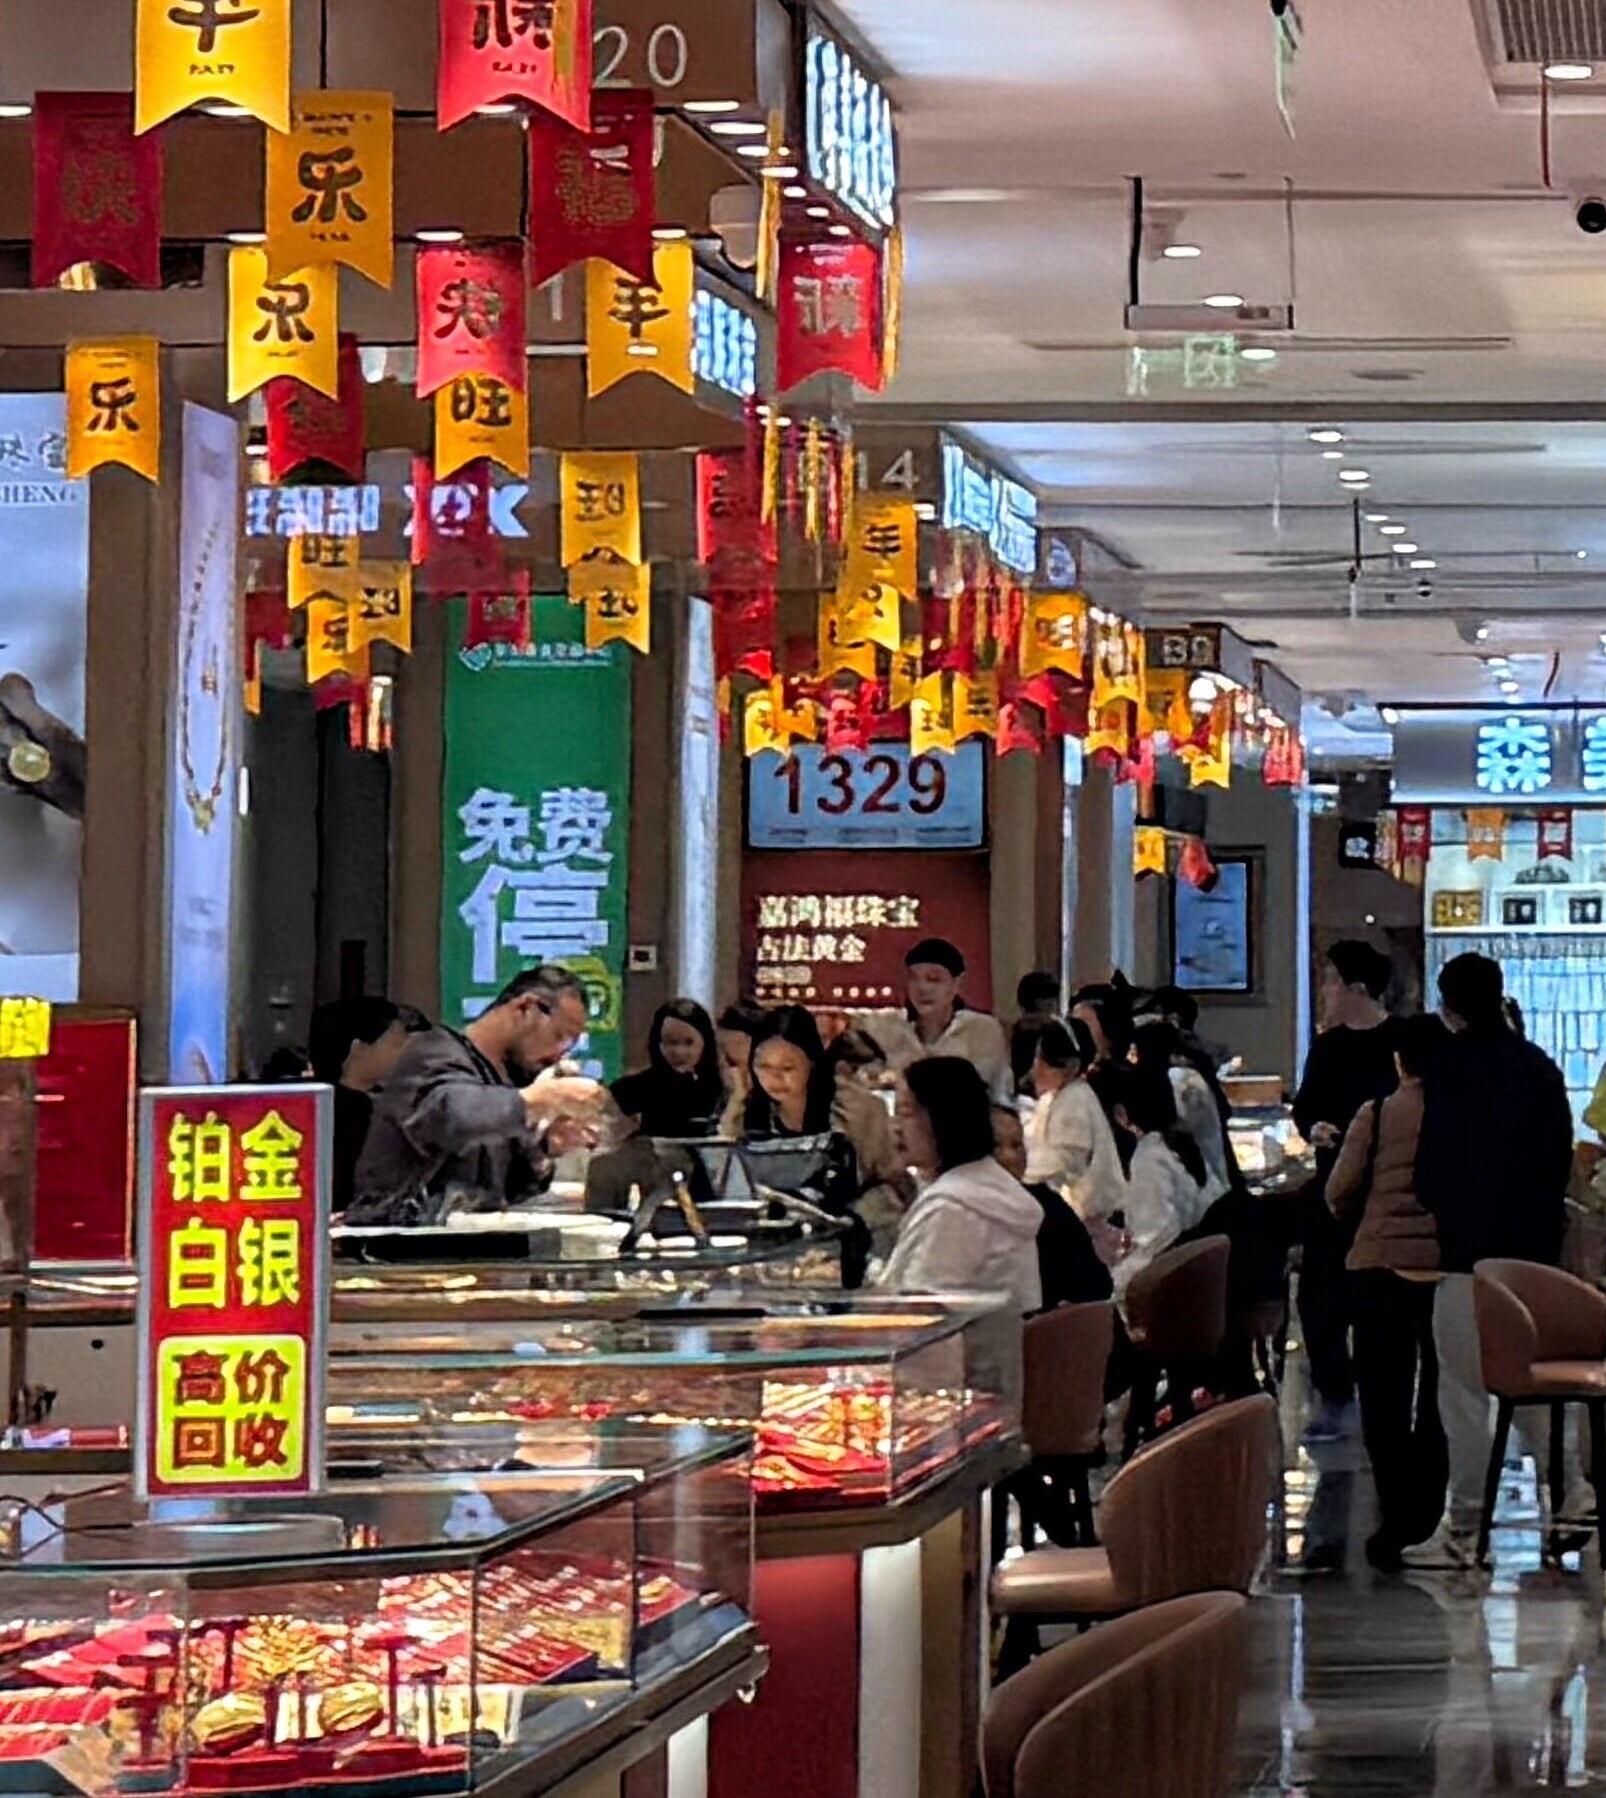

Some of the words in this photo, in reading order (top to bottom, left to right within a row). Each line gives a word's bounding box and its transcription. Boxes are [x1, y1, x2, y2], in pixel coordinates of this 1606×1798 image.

[592, 23, 687, 88] 20
[291, 146, 367, 223] 乐
[86, 376, 140, 433] 乐
[857, 449, 921, 490] 14
[774, 754, 947, 815] 1329
[459, 787, 613, 863] 免费
[459, 862, 608, 984] 停
[168, 1110, 303, 1203] 铂金
[168, 1217, 301, 1310] 白银
[173, 1349, 291, 1406] 高价
[173, 1413, 289, 1469] 回收
